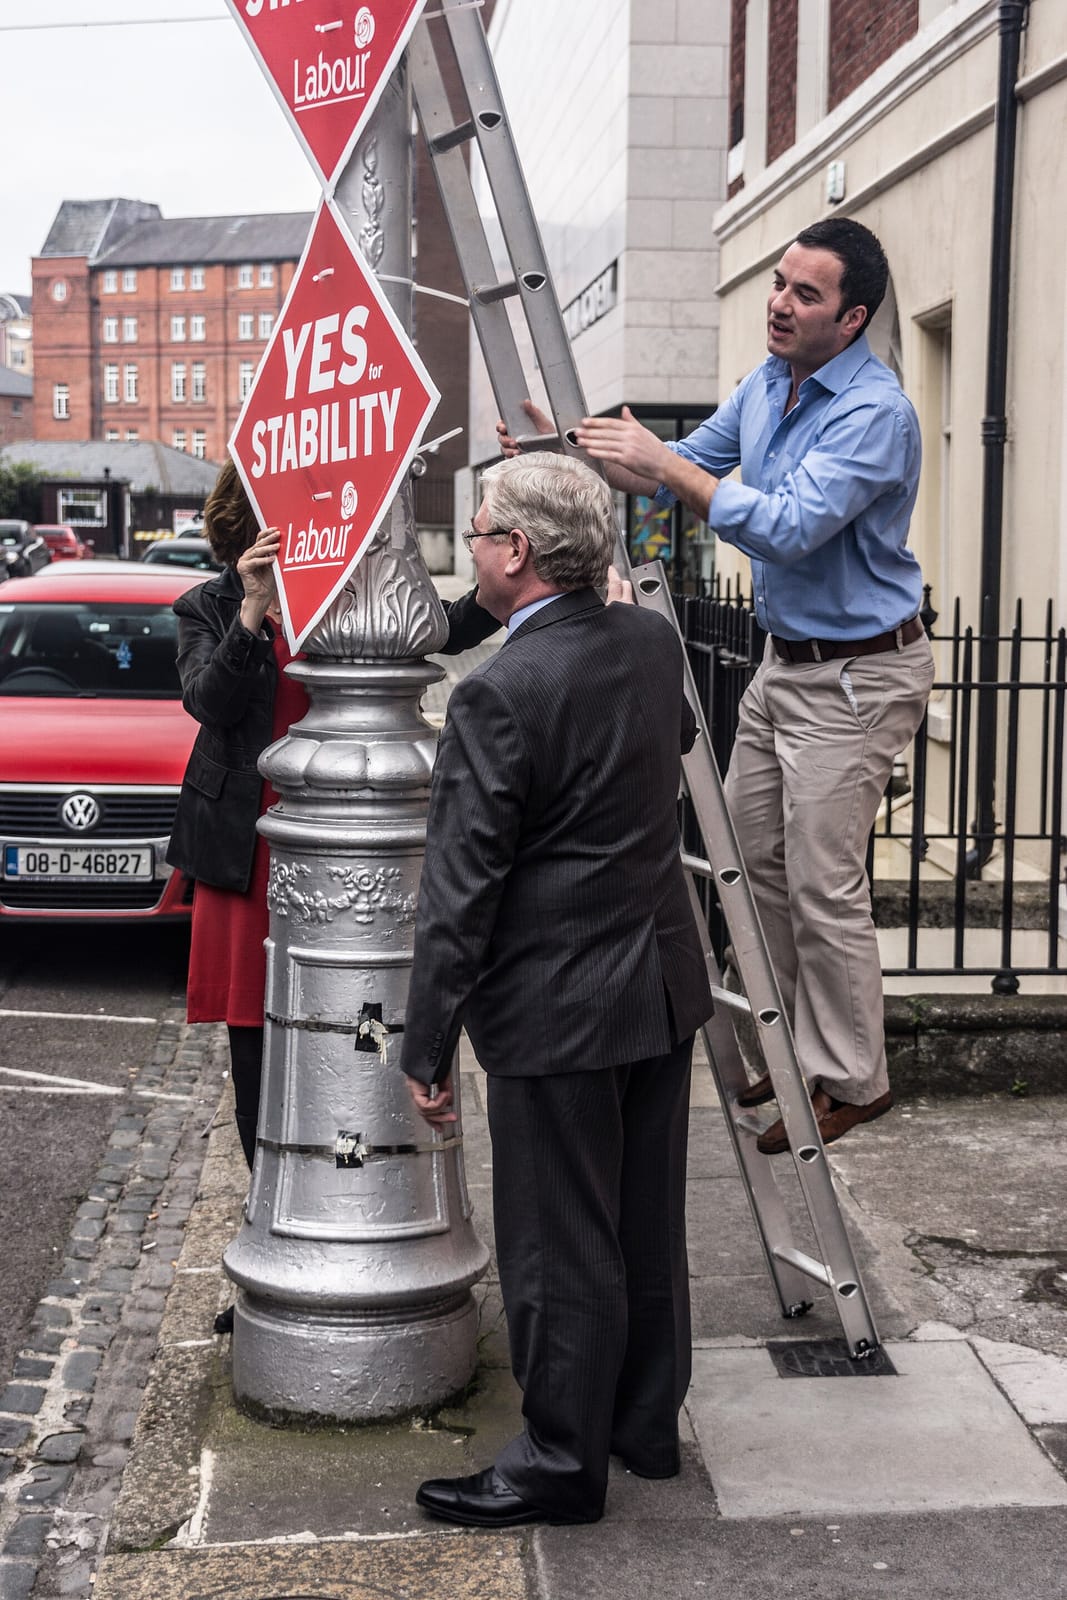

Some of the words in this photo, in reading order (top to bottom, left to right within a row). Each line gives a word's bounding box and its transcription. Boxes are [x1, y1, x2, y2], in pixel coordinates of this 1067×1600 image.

[294, 50, 371, 104] Labour
[282, 305, 370, 400] YES
[368, 363, 384, 380] for
[251, 387, 402, 478] STABILITY
[284, 518, 354, 564] Labour
[26, 852, 142, 874] 08-D-46827
